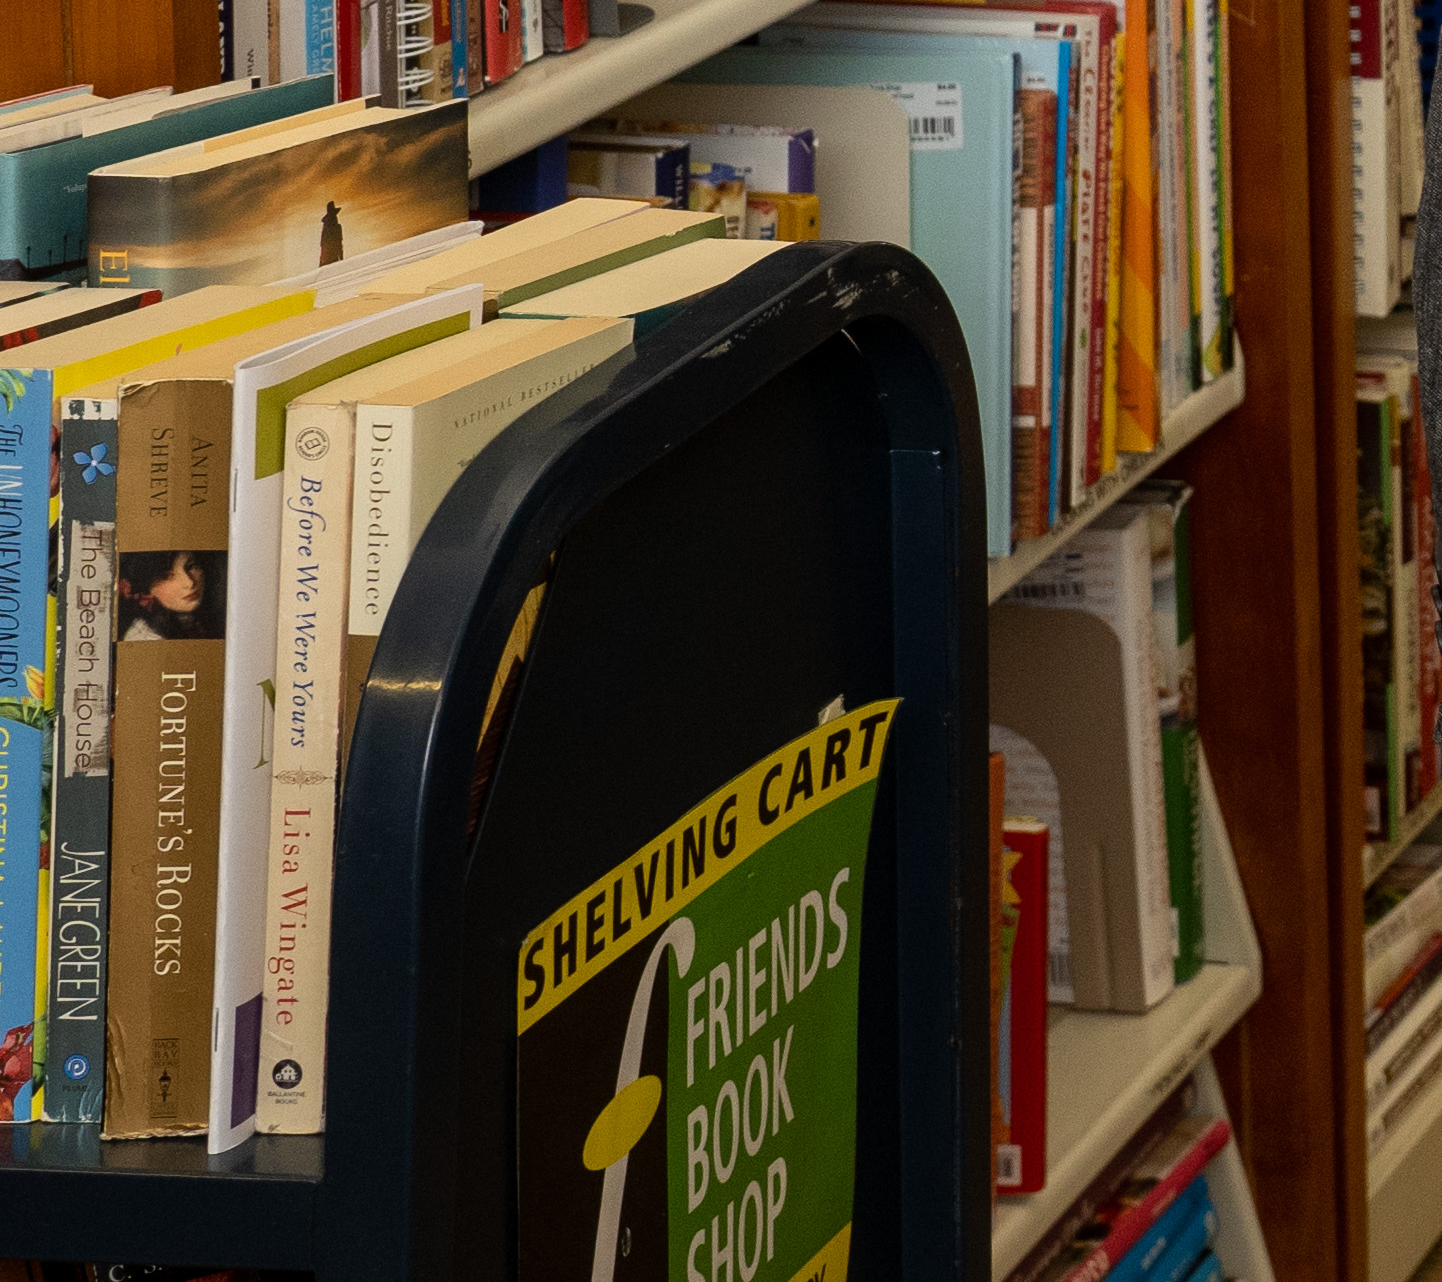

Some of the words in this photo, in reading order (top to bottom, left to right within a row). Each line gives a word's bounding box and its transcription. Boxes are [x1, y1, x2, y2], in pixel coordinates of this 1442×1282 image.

[454, 395, 514, 430] NATIONAL
[519, 362, 596, 404] BESTSELLER
[150, 427, 174, 519] SHREVE
[189, 437, 214, 509] ANITA
[287, 475, 326, 559] Before
[78, 535, 103, 581] The
[363, 420, 394, 617] Disobedience
[296, 564, 320, 603] We
[77, 590, 96, 672] Beach
[293, 610, 319, 675] Were
[73, 683, 93, 773] House
[290, 679, 316, 748] Yours
[157, 671, 197, 853] FORTUNE'S
[282, 807, 313, 874] Lisa
[523, 792, 738, 1012] SHELVING
[757, 709, 889, 828] CART
[153, 862, 193, 977] ROCKS
[267, 883, 309, 1026] Wingate
[687, 866, 851, 1089] FRIENDS
[687, 1024, 797, 1216] BOOK
[687, 1155, 788, 1282] SHOP
